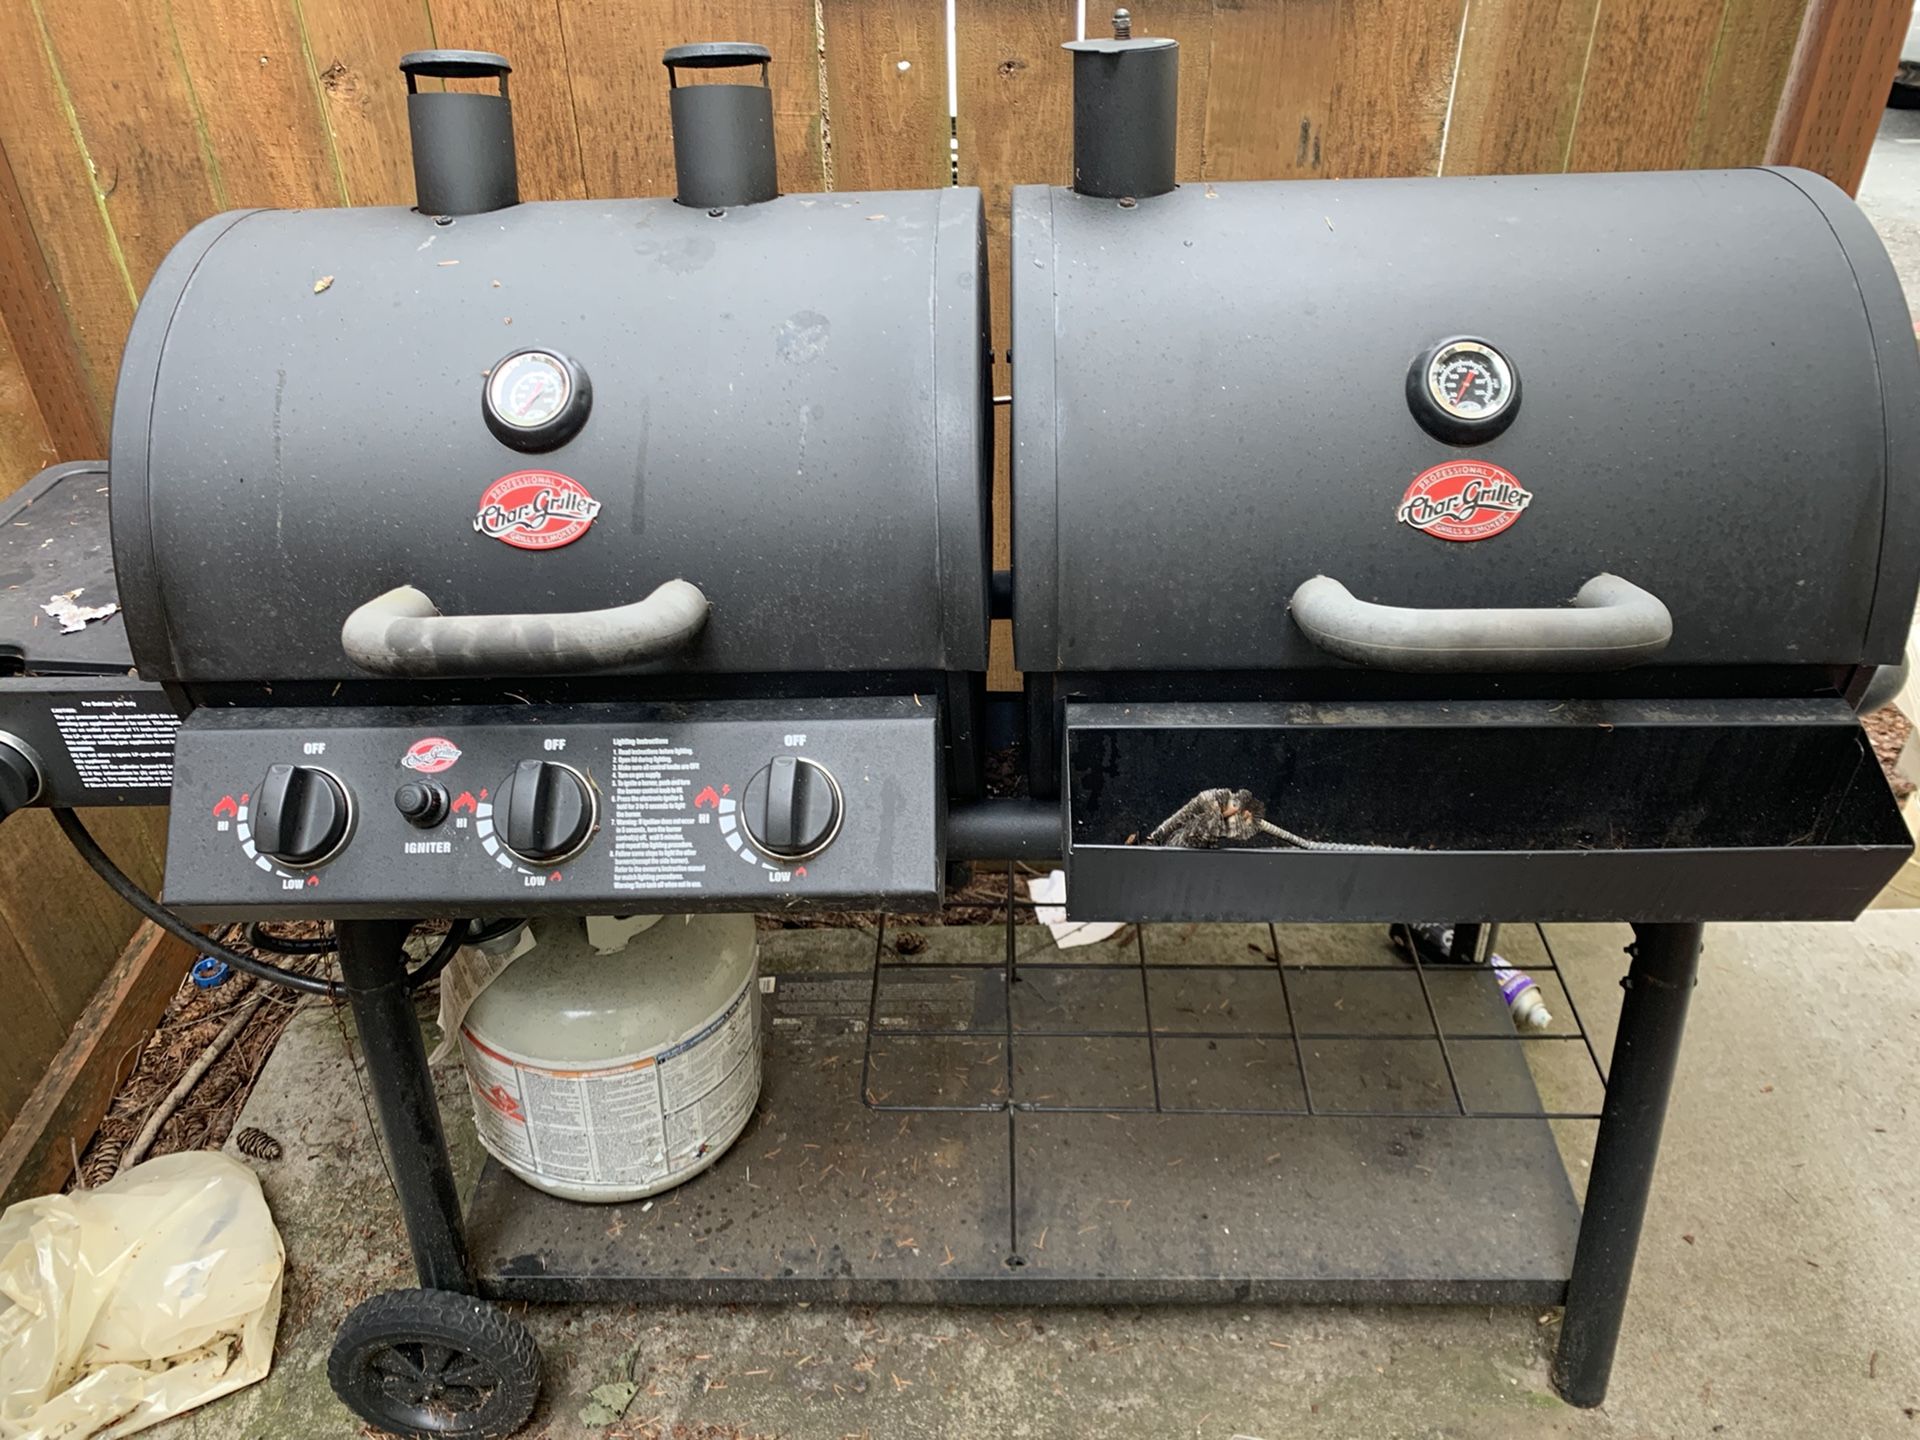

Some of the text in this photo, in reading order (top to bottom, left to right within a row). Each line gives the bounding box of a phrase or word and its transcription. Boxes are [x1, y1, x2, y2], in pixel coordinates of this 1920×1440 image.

[1419, 466, 1488, 490] PROFESSIONAL
[1434, 523, 1462, 535] GRILLS
[1472, 515, 1510, 535] SMOKERS
[544, 739, 566, 751] OFF
[784, 734, 806, 747] OFF
[303, 743, 326, 755] OFF
[456, 818, 467, 828] HI
[698, 813, 710, 824] HI
[217, 821, 229, 831] HI
[404, 842, 451, 854] IGNITER
[524, 876, 546, 887] LOW
[769, 871, 791, 882] LOW
[282, 879, 304, 890] LOW
